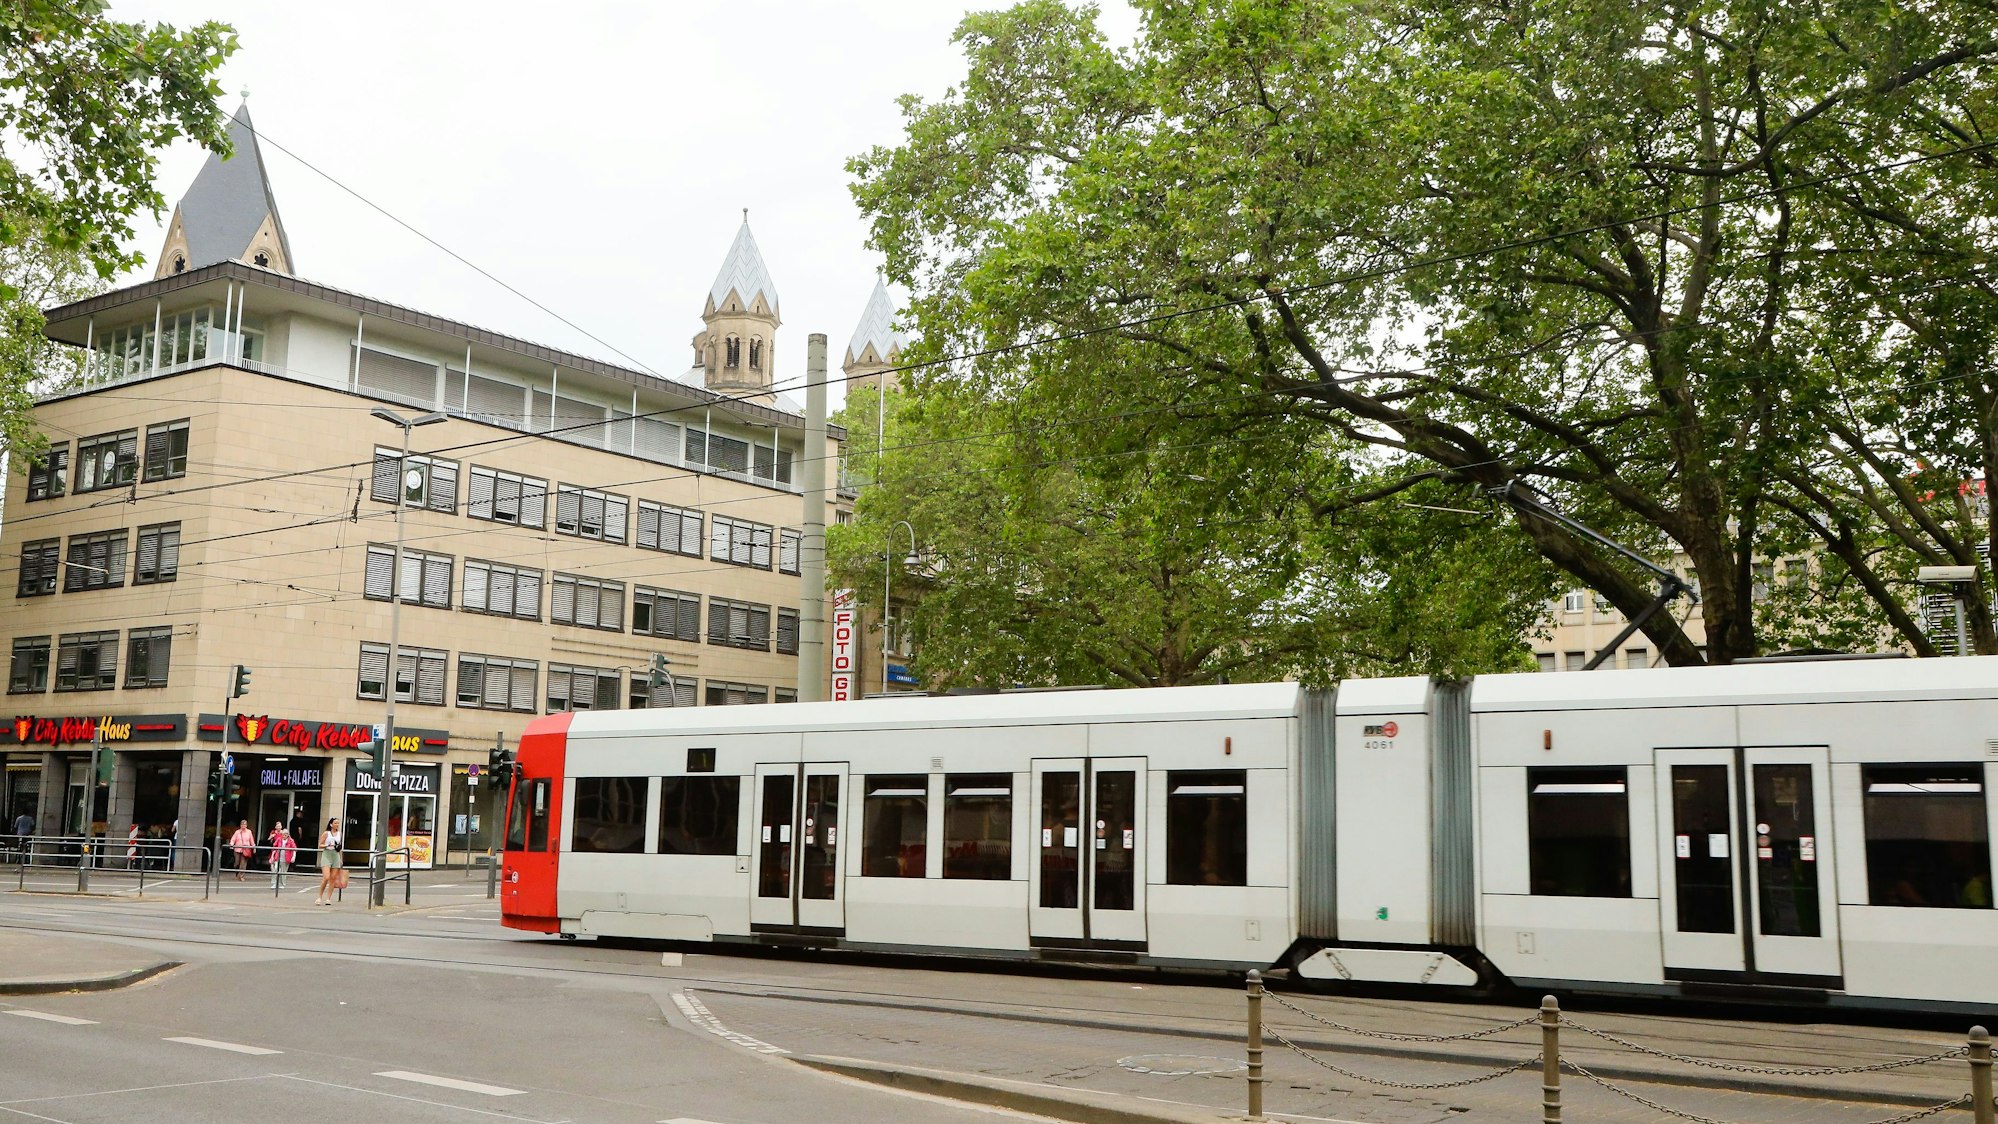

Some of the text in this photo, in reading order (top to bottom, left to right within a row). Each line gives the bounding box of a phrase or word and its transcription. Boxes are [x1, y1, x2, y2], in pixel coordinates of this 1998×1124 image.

[836, 613, 850, 669] FOTO
[35, 715, 131, 747] City Kebab Haus
[271, 719, 312, 751] City
[316, 722, 371, 750] Kebab
[391, 735, 420, 752] aus
[261, 769, 322, 786] GRILL FALAFEL
[356, 772, 429, 791] DON PIZZA
